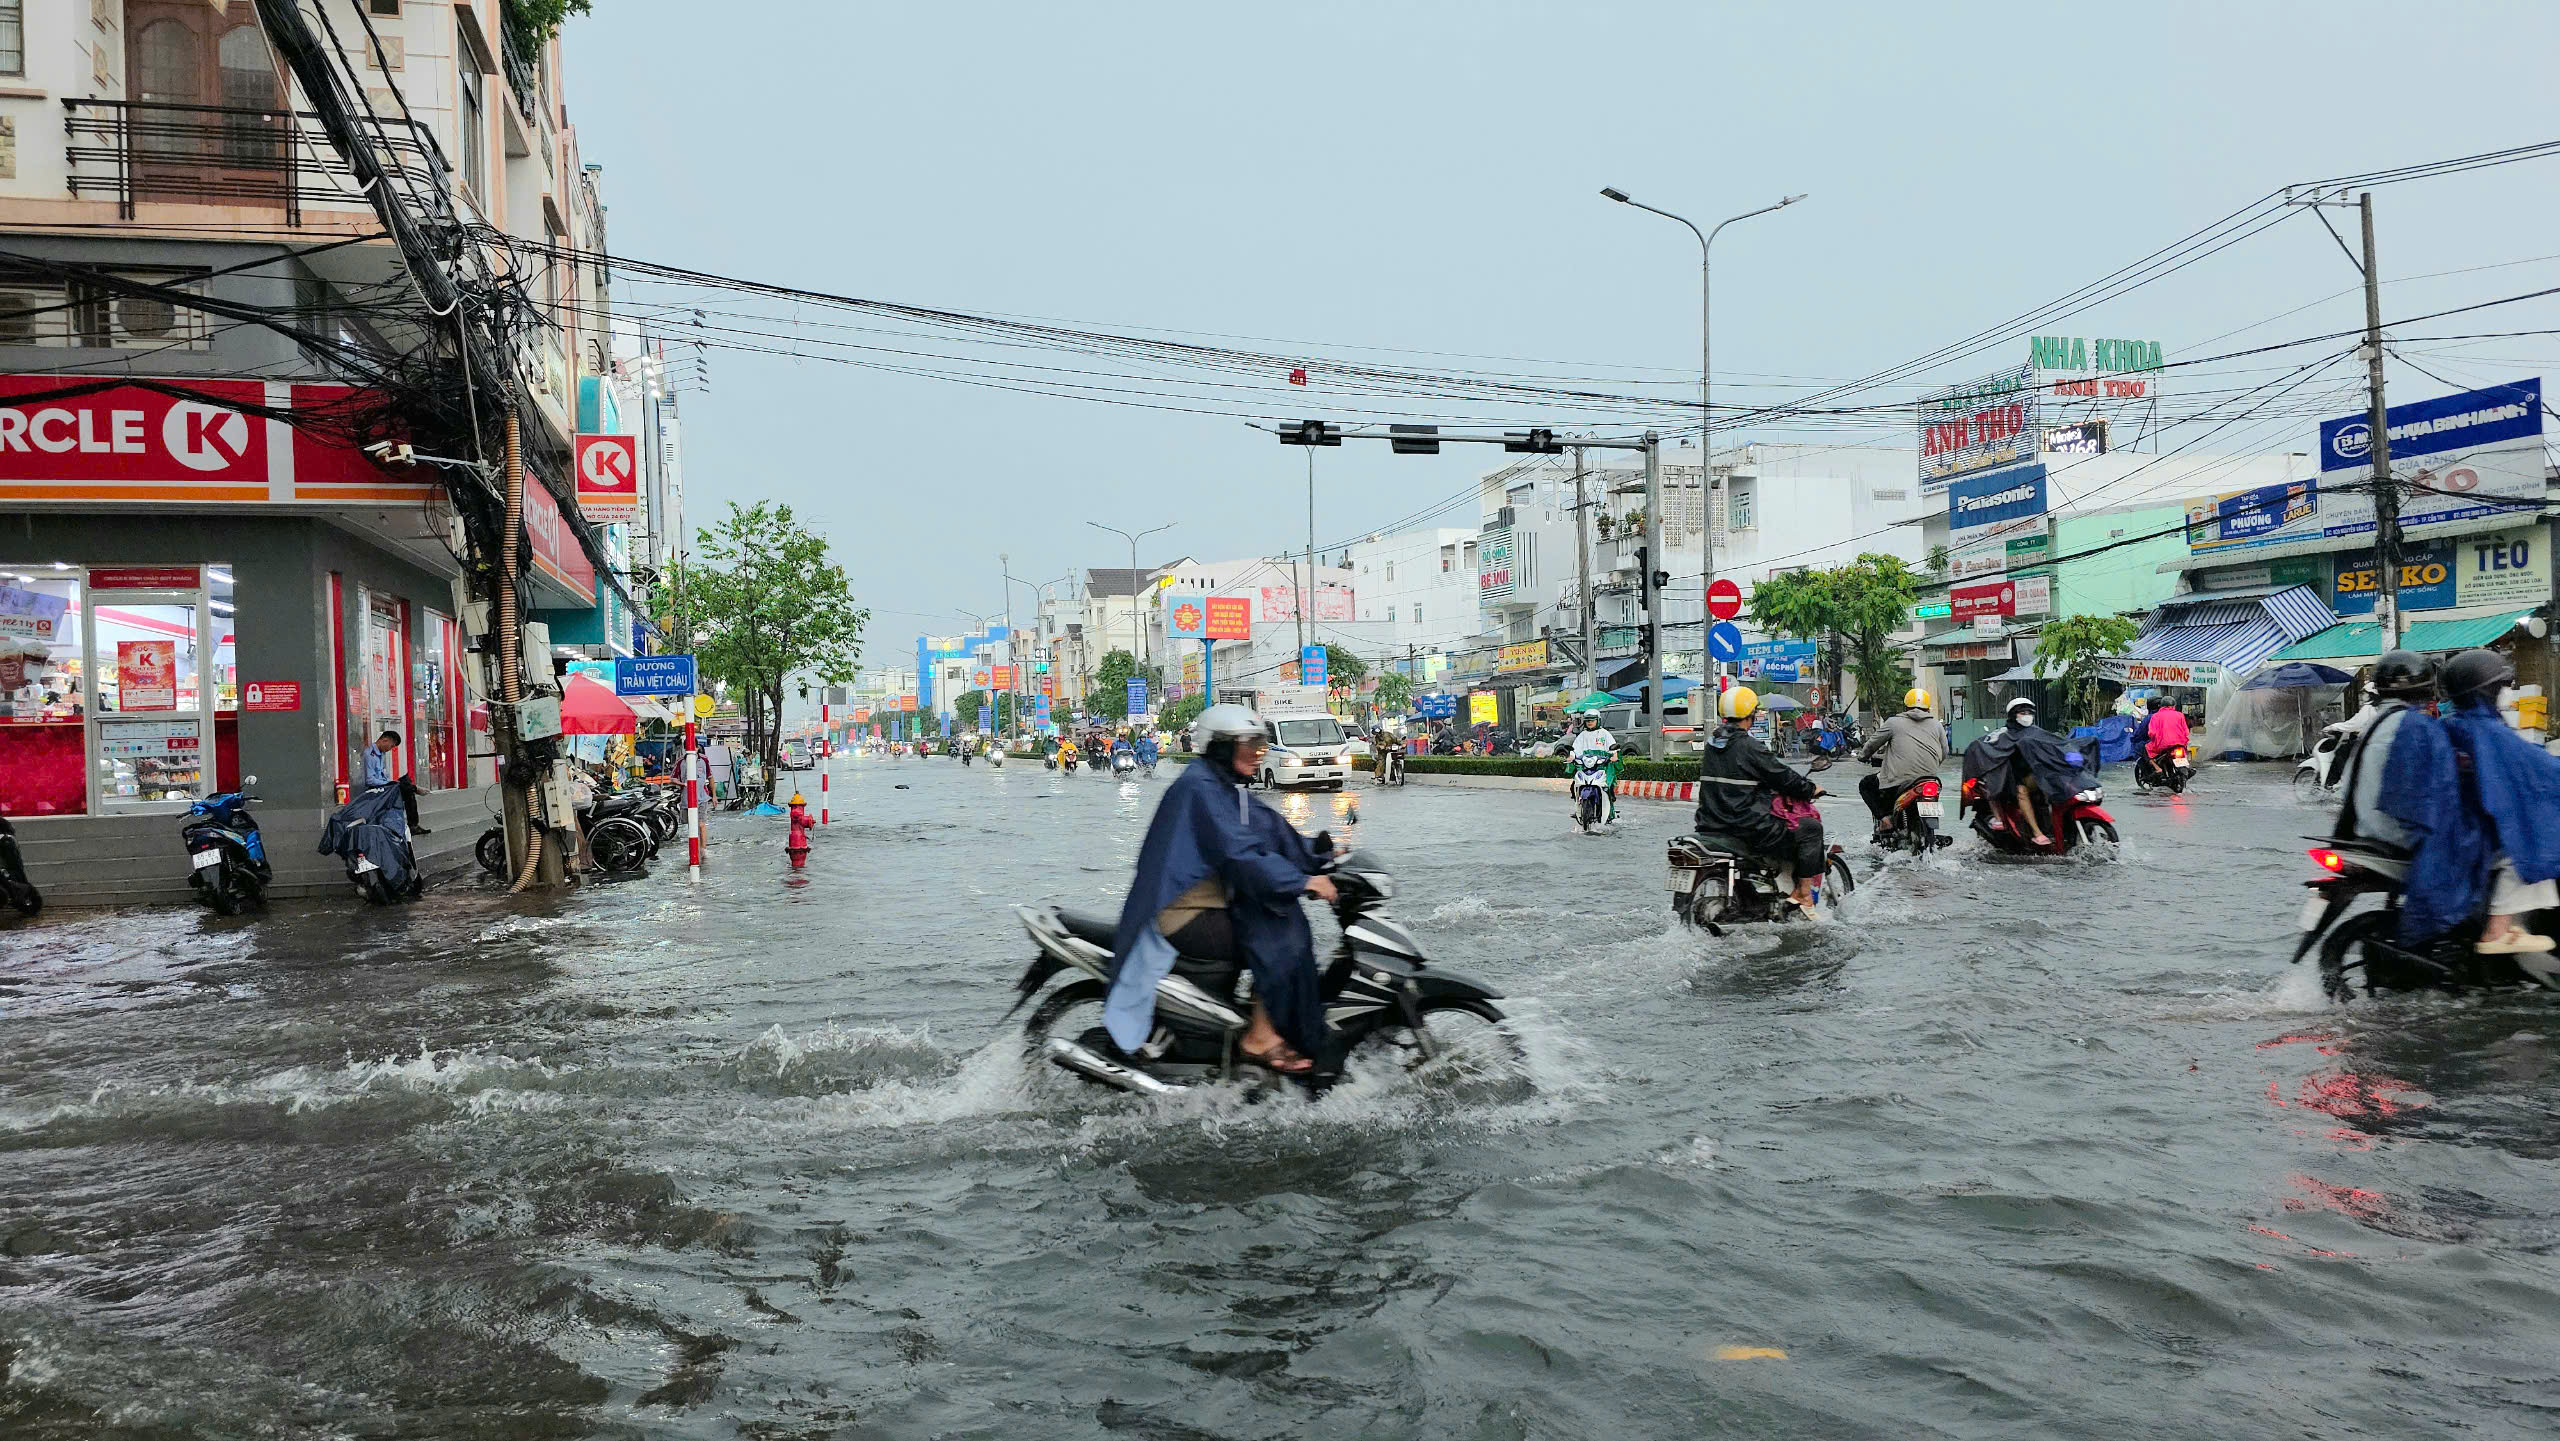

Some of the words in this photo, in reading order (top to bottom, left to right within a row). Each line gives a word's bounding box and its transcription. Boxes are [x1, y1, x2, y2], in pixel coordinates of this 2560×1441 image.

[2031, 335, 2088, 371] NHA
[2096, 338, 2165, 374] KHOA
[2054, 378, 2099, 396] ANH
[1924, 415, 1970, 457] ANH
[1957, 484, 2037, 513] Panasonic
[2230, 513, 2272, 530] PHƯƠNG
[2283, 503, 2312, 522] LARUE
[2474, 535, 2529, 572] TÈO
[1492, 568, 1510, 586] VUI
[2337, 563, 2448, 592] SEKO
[635, 659, 675, 671] ĐƯỜNG
[2151, 664, 2191, 683] PHƯƠNG
[622, 673, 646, 689] TRẦN
[646, 674, 664, 690] VIỆT
[665, 672, 688, 688] CHÂU
